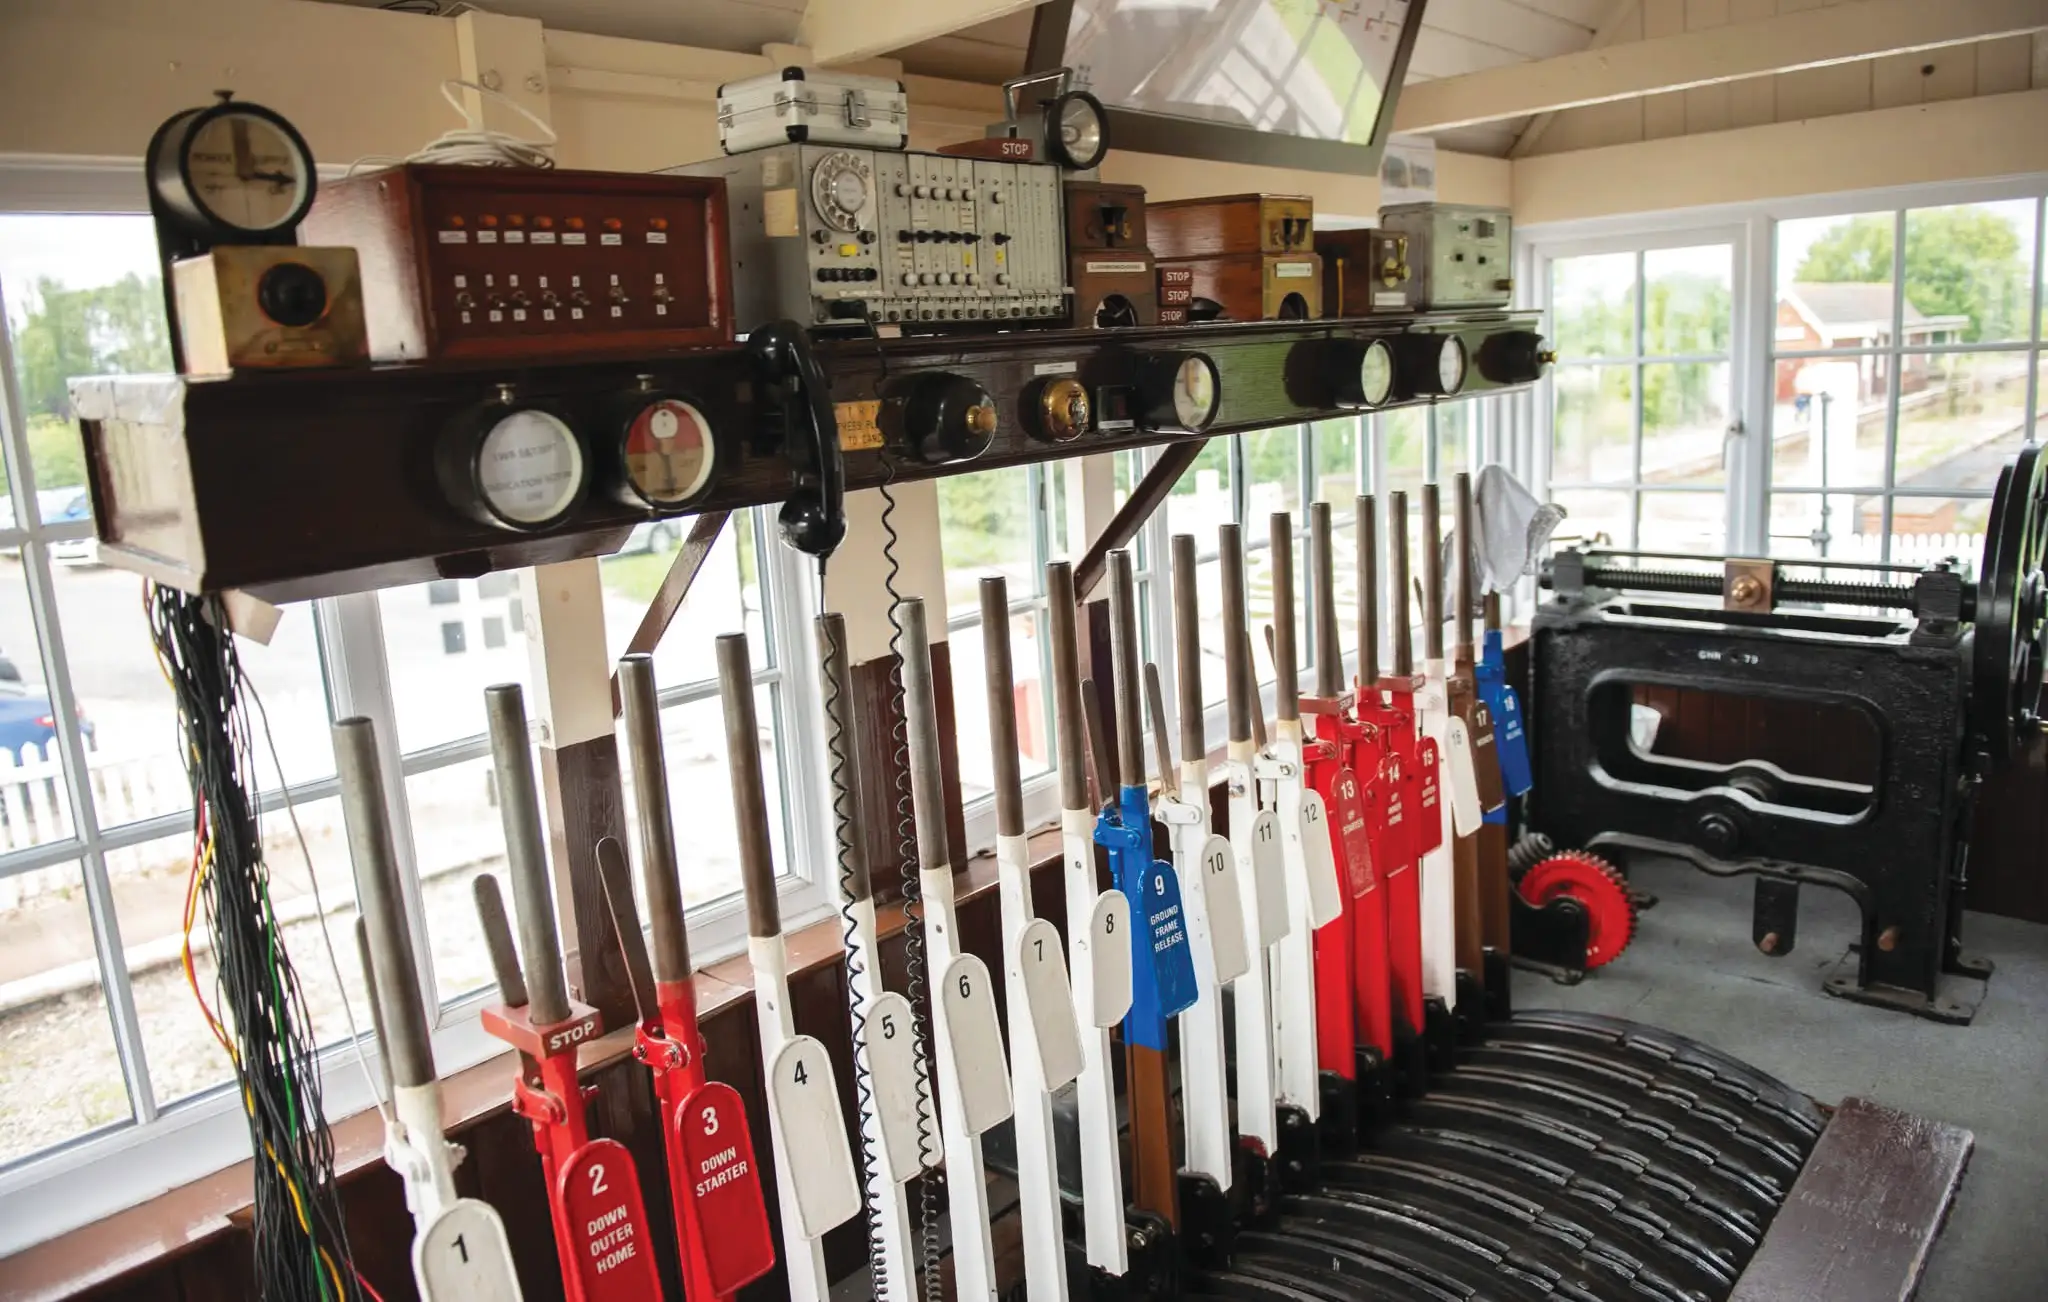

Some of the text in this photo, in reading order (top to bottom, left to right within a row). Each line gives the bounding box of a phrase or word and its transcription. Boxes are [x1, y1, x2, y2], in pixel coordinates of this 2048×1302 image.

[1002, 143, 1029, 155] STOP
[1166, 271, 1190, 282] STOP
[1167, 290, 1189, 301] STOP
[1161, 310, 1182, 321] STOP
[1476, 709, 1487, 728] 17
[1422, 748, 1434, 767] 15
[1387, 762, 1400, 783] 14
[1341, 779, 1355, 800] 13
[1304, 803, 1318, 823] 12
[1258, 821, 1272, 842] 11
[1207, 852, 1224, 875] 10
[1155, 875, 1165, 896] 9
[1106, 912, 1114, 934] 8
[1150, 904, 1179, 925] GROUND
[1155, 918, 1179, 938] FRAME
[1033, 939, 1044, 962] 7
[1154, 930, 1184, 953] RELEASE
[958, 974, 971, 999] 6
[550, 1020, 595, 1050] STOP
[882, 1014, 896, 1039] 5
[794, 1059, 808, 1085] 4
[702, 1106, 719, 1136] 3
[701, 1146, 737, 1175] DOWN
[588, 1163, 609, 1196] 2
[696, 1160, 749, 1197] STARTER
[587, 1203, 628, 1237] DOWN
[451, 1233, 468, 1264] 1
[590, 1221, 635, 1257] OUTER
[596, 1241, 637, 1275] HOME
